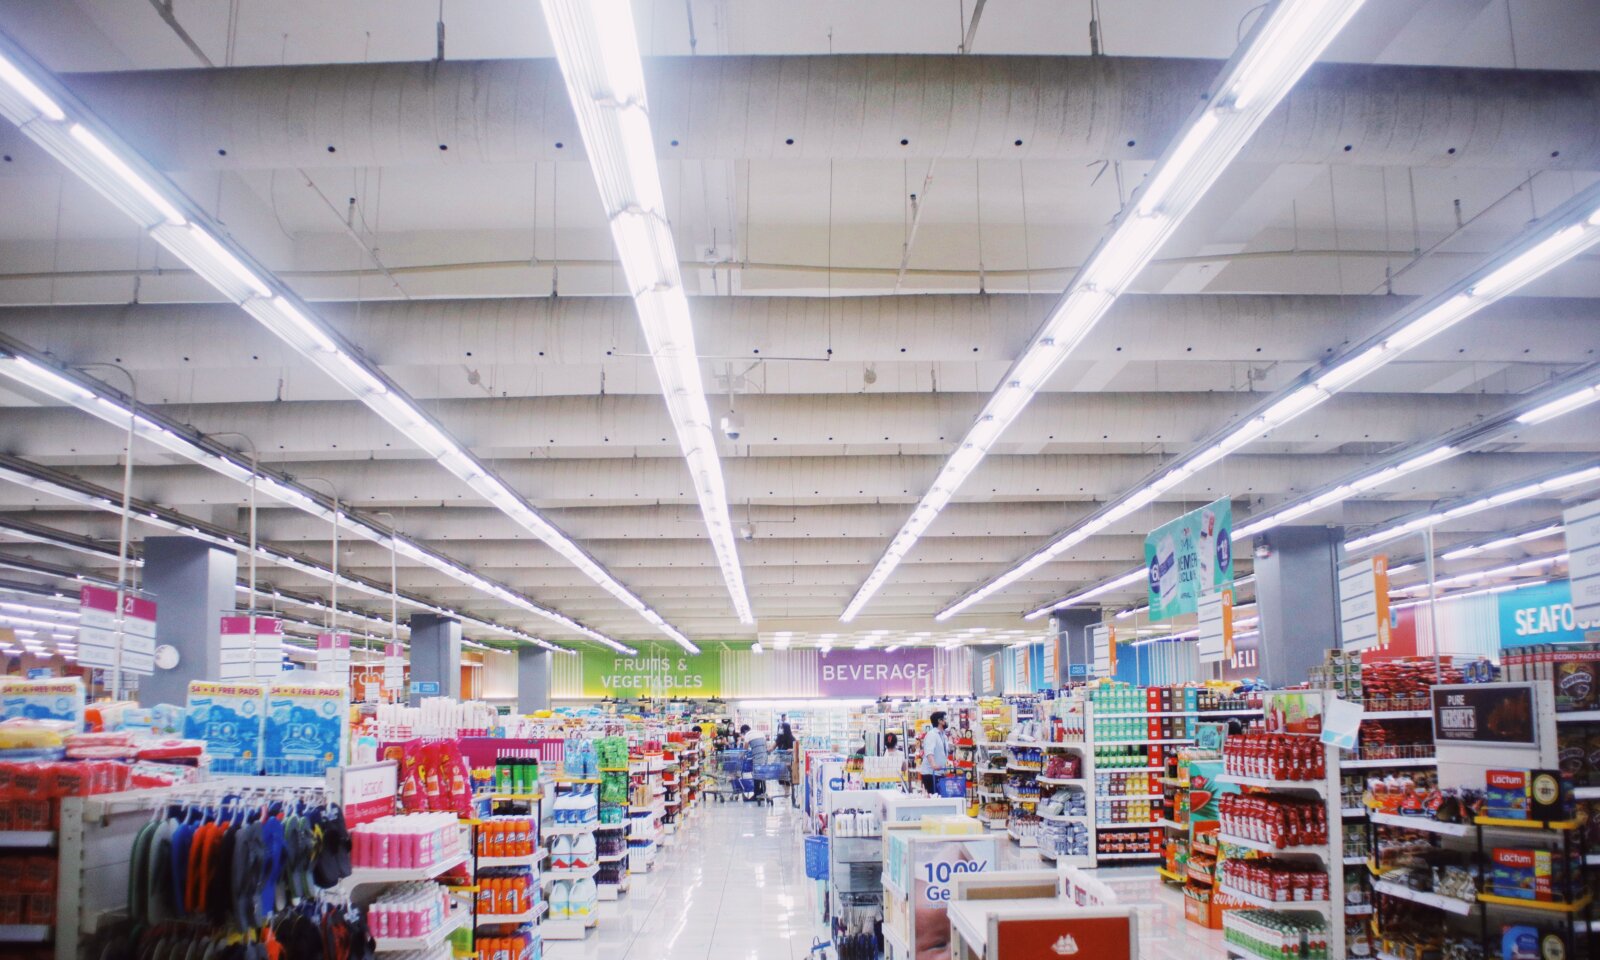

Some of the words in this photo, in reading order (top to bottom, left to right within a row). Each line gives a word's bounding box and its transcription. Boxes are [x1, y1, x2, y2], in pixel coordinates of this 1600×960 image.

[125, 597, 134, 614] 21
[1515, 603, 1600, 636] SEAFO
[274, 620, 283, 633] 22
[615, 658, 670, 671] FRUITS
[677, 658, 688, 671] &
[1230, 649, 1256, 669] DELI
[823, 663, 928, 681] BEVERAGE
[601, 675, 703, 688] VEGETABLES
[218, 686, 236, 695] FREE
[238, 687, 260, 696] PADS
[298, 687, 317, 696] FREE
[319, 688, 341, 697] PADS
[1447, 694, 1465, 706] PURE
[206, 721, 237, 741] EQ
[286, 723, 318, 743] EQ
[1492, 775, 1522, 785] Lactum
[1500, 853, 1531, 864] Lactum
